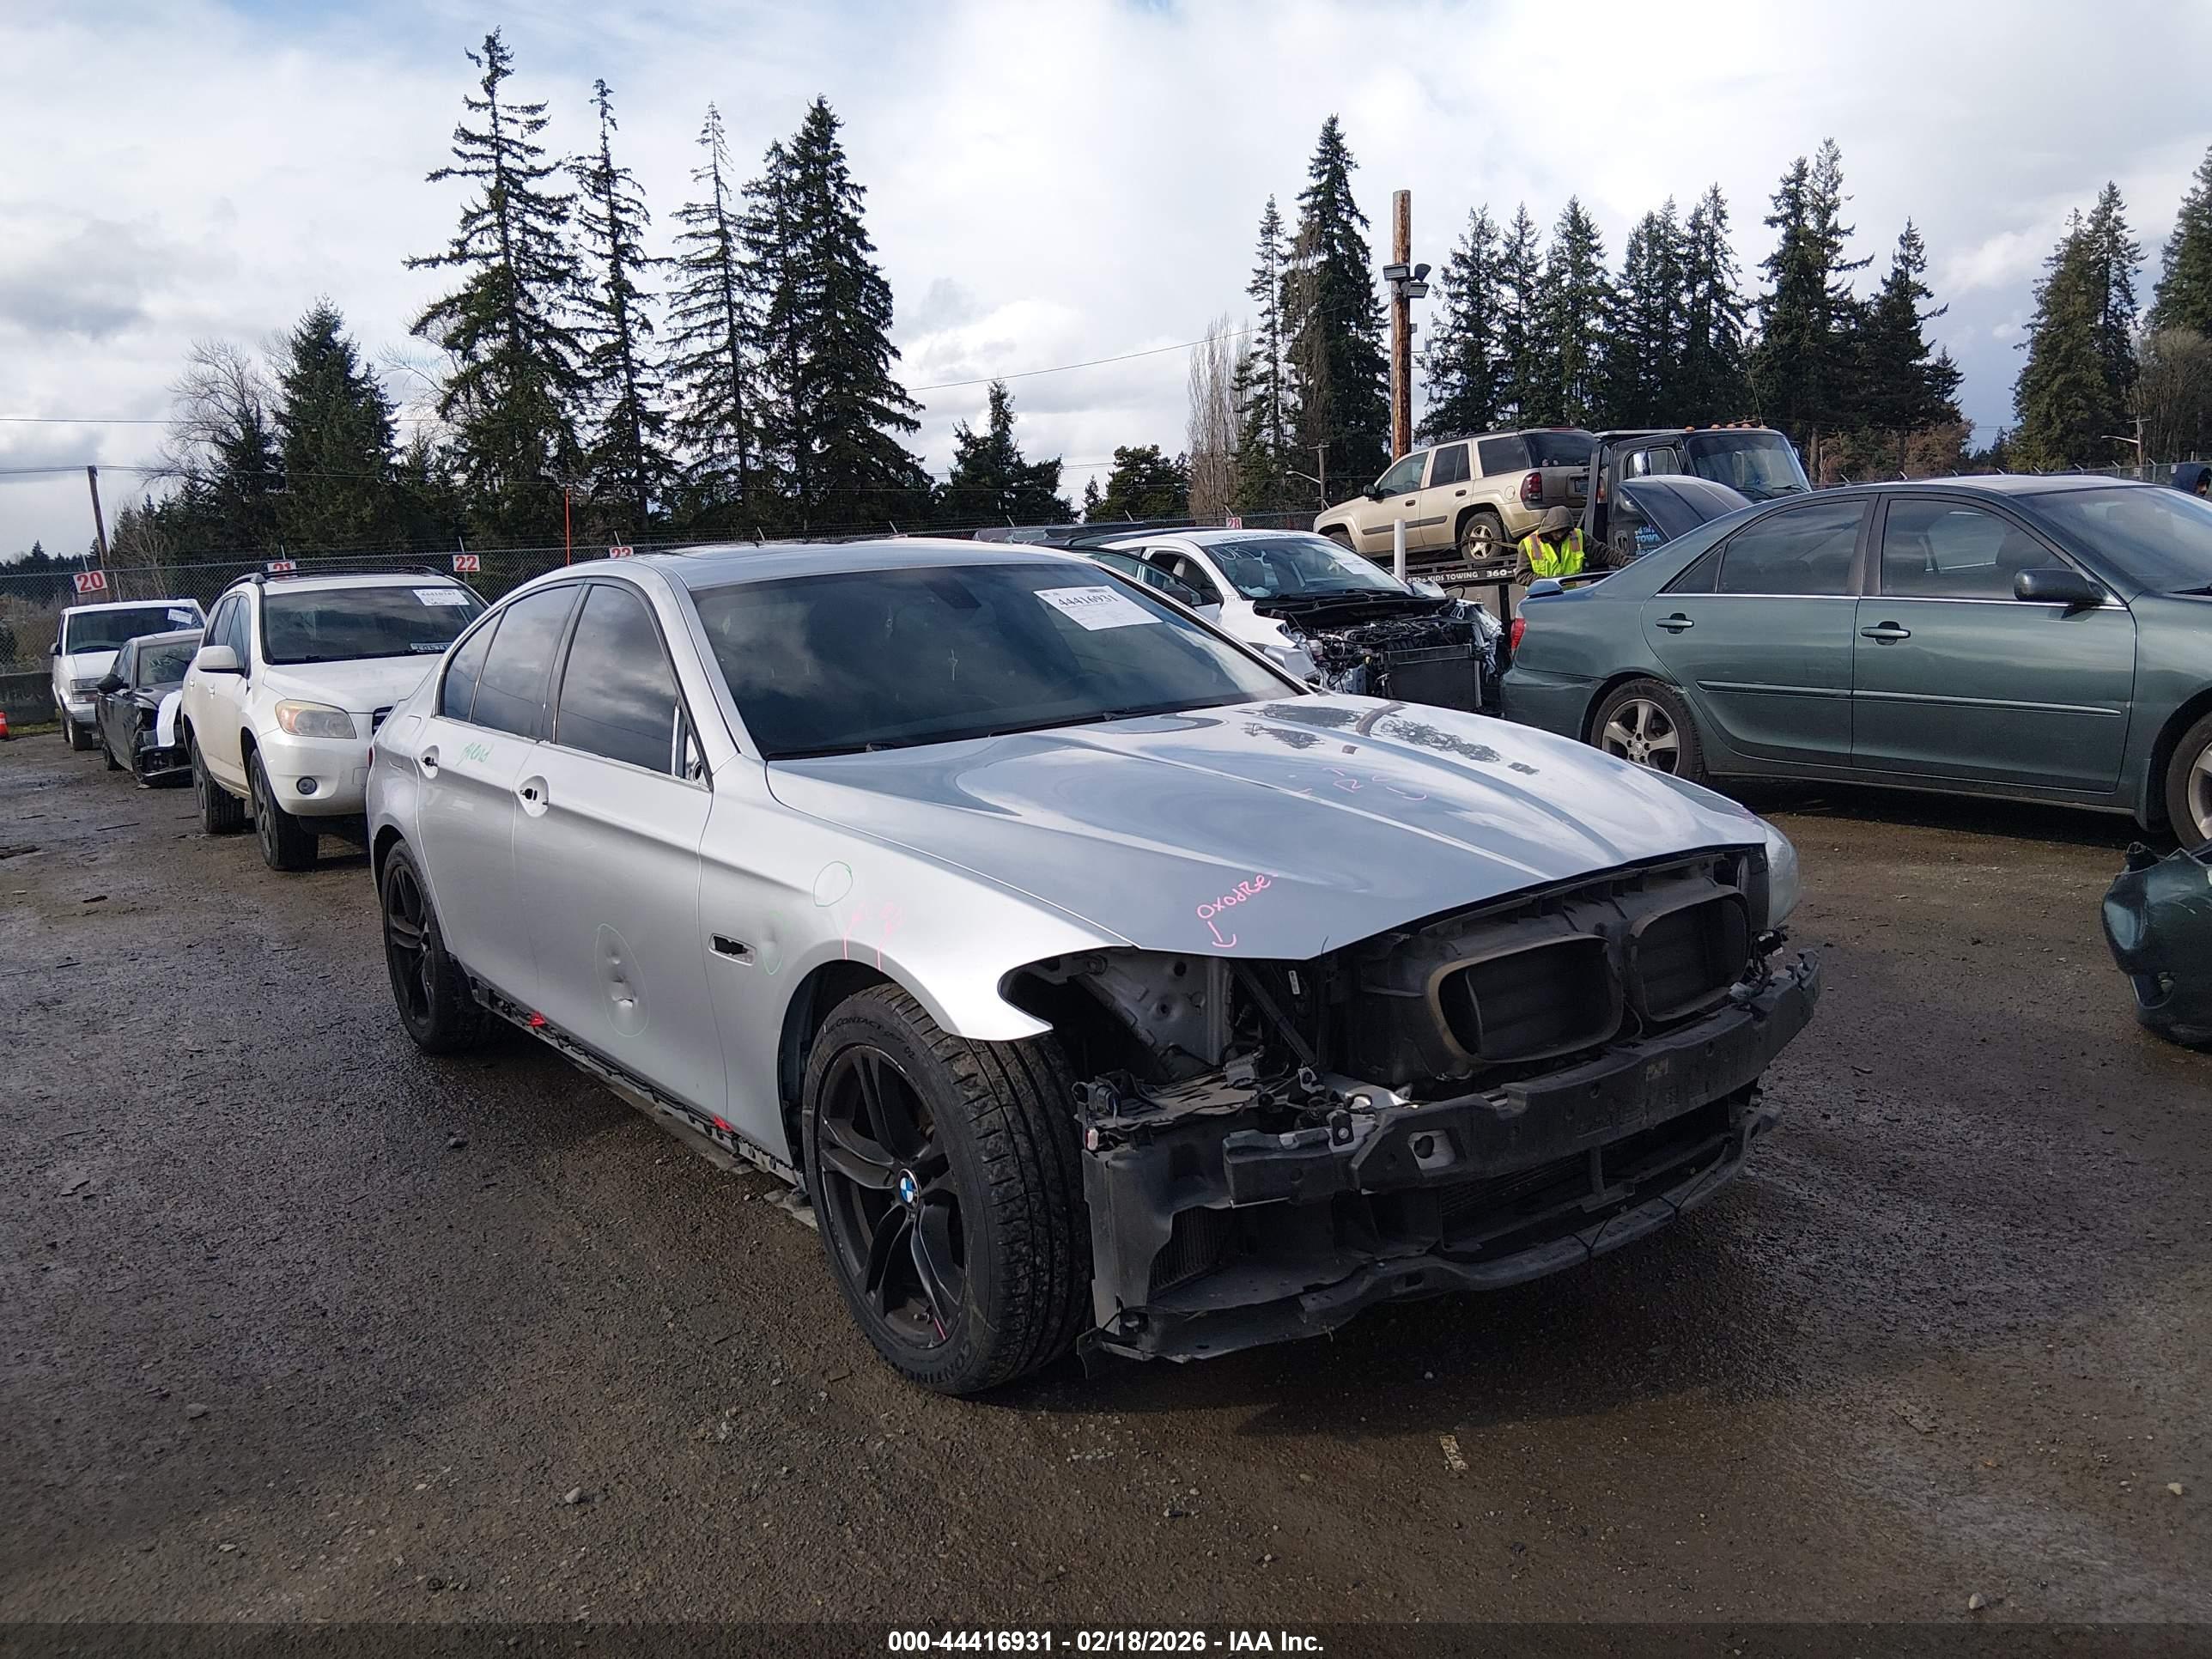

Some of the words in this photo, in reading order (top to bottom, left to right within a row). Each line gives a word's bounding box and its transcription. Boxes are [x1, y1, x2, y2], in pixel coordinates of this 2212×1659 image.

[1227, 518, 1241, 529] 28
[455, 556, 477, 571] 22
[76, 571, 105, 592] 20
[1446, 571, 1479, 580] TOWING
[1058, 593, 1119, 606] 44416931
